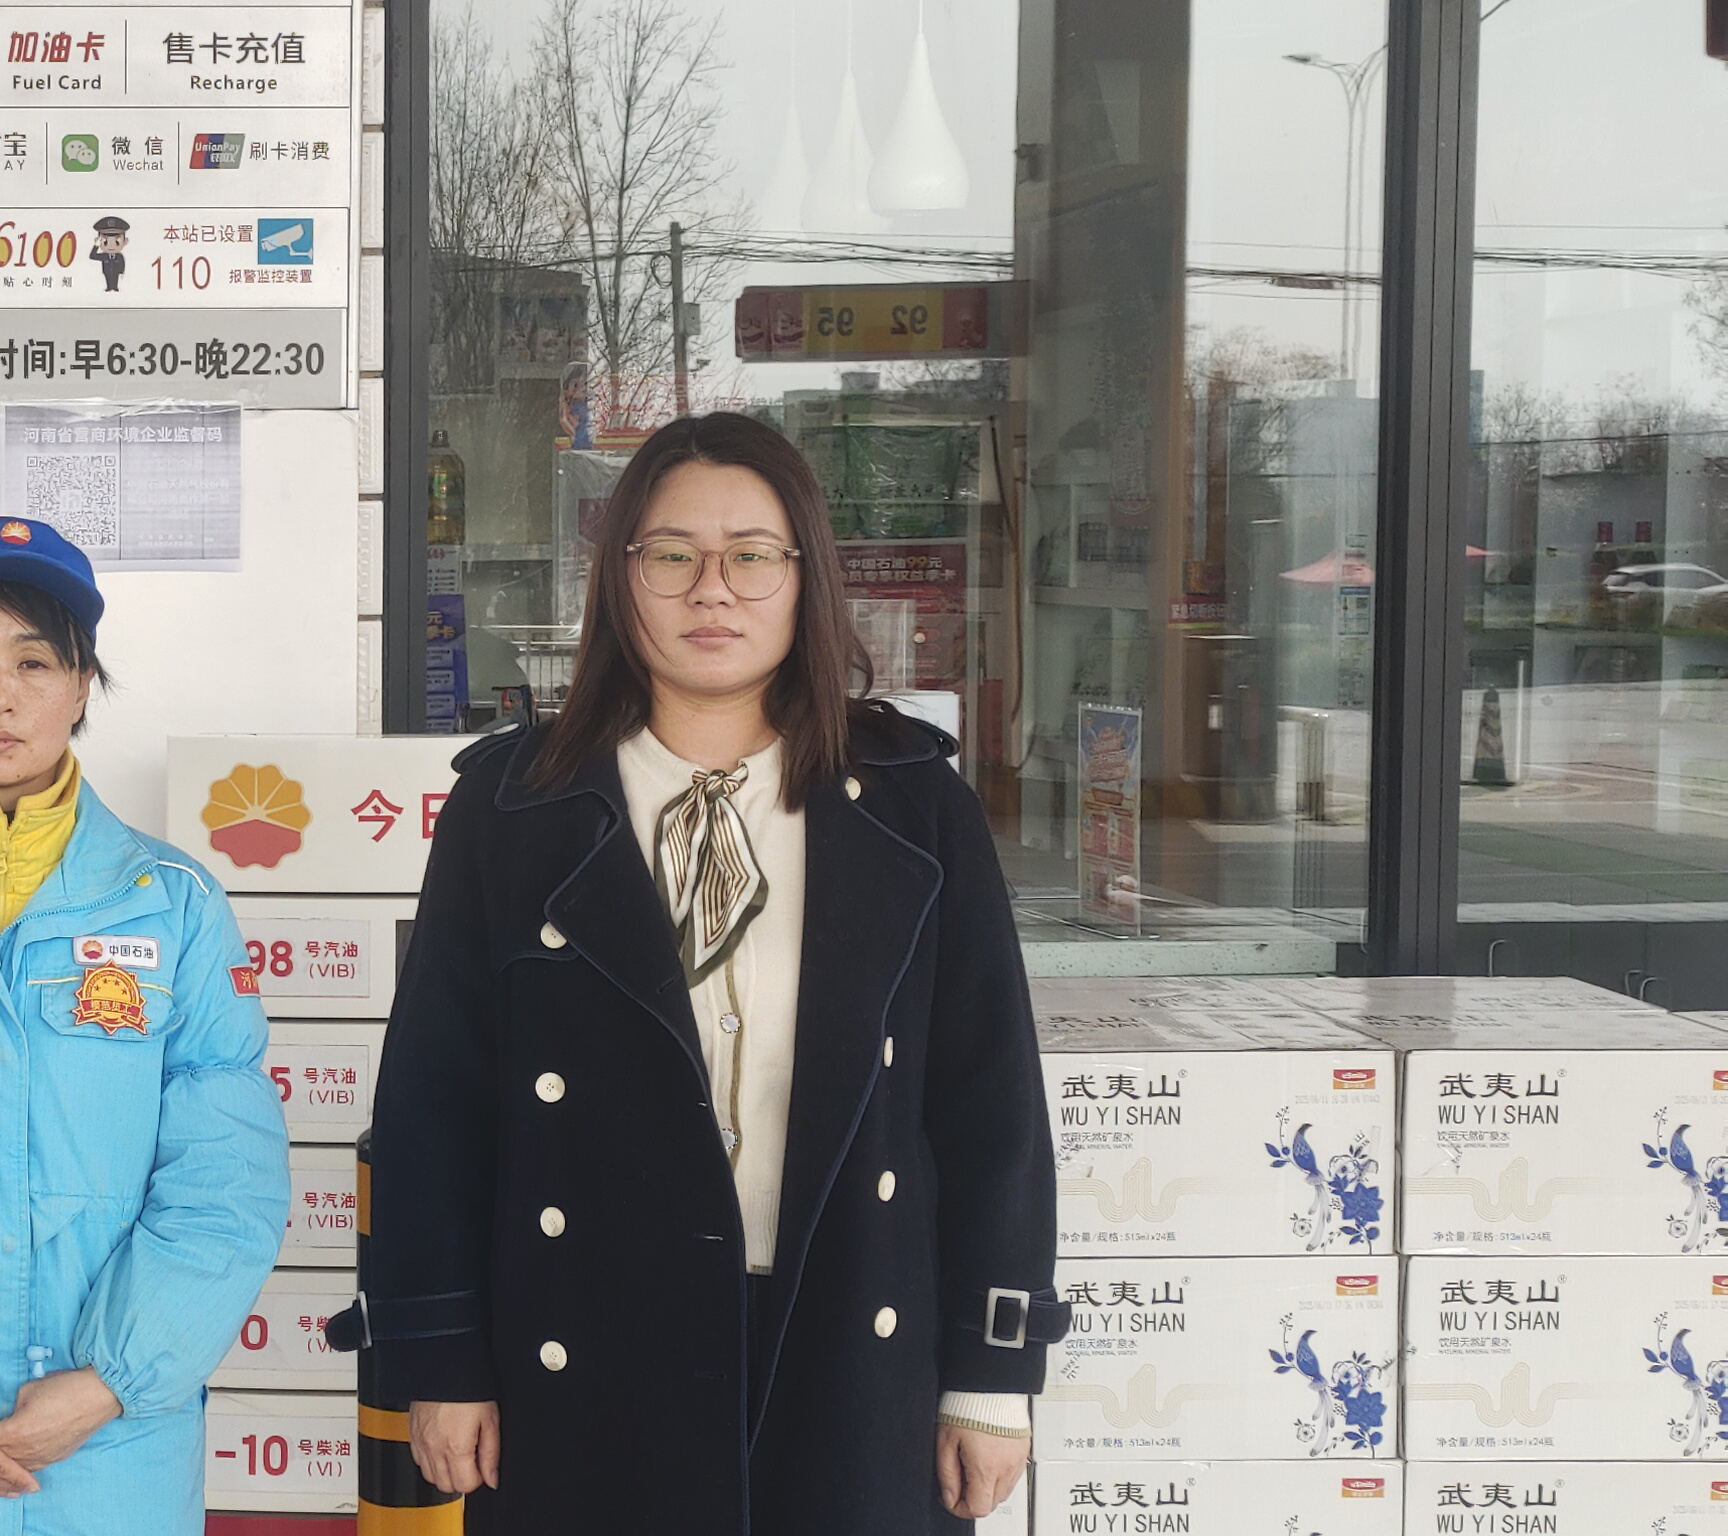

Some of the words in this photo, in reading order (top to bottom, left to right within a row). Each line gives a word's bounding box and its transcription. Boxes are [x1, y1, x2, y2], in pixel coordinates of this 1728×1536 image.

[7, 31, 105, 63] 加油卡
[162, 31, 306, 65] 售卡充值
[12, 74, 51, 90] Fuel
[58, 74, 102, 90] Card
[190, 74, 278, 94] Recharge
[111, 136, 164, 156] 微信
[195, 141, 241, 153] UnionPay
[249, 141, 330, 161] 刷卡消费
[112, 159, 164, 171] Wechat
[163, 224, 253, 243] 本站已设置
[151, 255, 211, 290] 110
[229, 269, 313, 284] 报警监控装置
[109, 944, 154, 959] 中国石油
[248, 940, 293, 976] 98
[304, 941, 358, 958] 号汽油
[309, 963, 355, 979] (VIB)
[303, 1067, 357, 1085] 号汽油
[1438, 1072, 1559, 1099] 武夷山
[1060, 1073, 1182, 1100] 武夷山
[308, 1089, 355, 1105] (VIB)
[1060, 1106, 1089, 1127] WU
[1126, 1105, 1181, 1126] SHAN
[1437, 1104, 1466, 1125] WU
[1503, 1104, 1559, 1125] SHAN
[302, 1191, 356, 1210] 号汽油
[307, 1214, 354, 1230] (VIB)
[1064, 1280, 1184, 1308] 武夷山
[1439, 1278, 1560, 1305] 武夷山
[1129, 1312, 1185, 1333] SHAN
[1439, 1311, 1467, 1332] WU
[1504, 1310, 1560, 1331] SHAN
[215, 1434, 288, 1476] -10
[297, 1439, 351, 1456] 号柴油
[307, 1461, 343, 1477] (VI)
[1069, 1481, 1190, 1508] 武夷山
[1436, 1482, 1557, 1509] 武夷山
[1069, 1513, 1097, 1534] WU
[1134, 1513, 1190, 1534] SHAN
[1436, 1513, 1464, 1534] WU
[1501, 1514, 1557, 1534] SHAN
